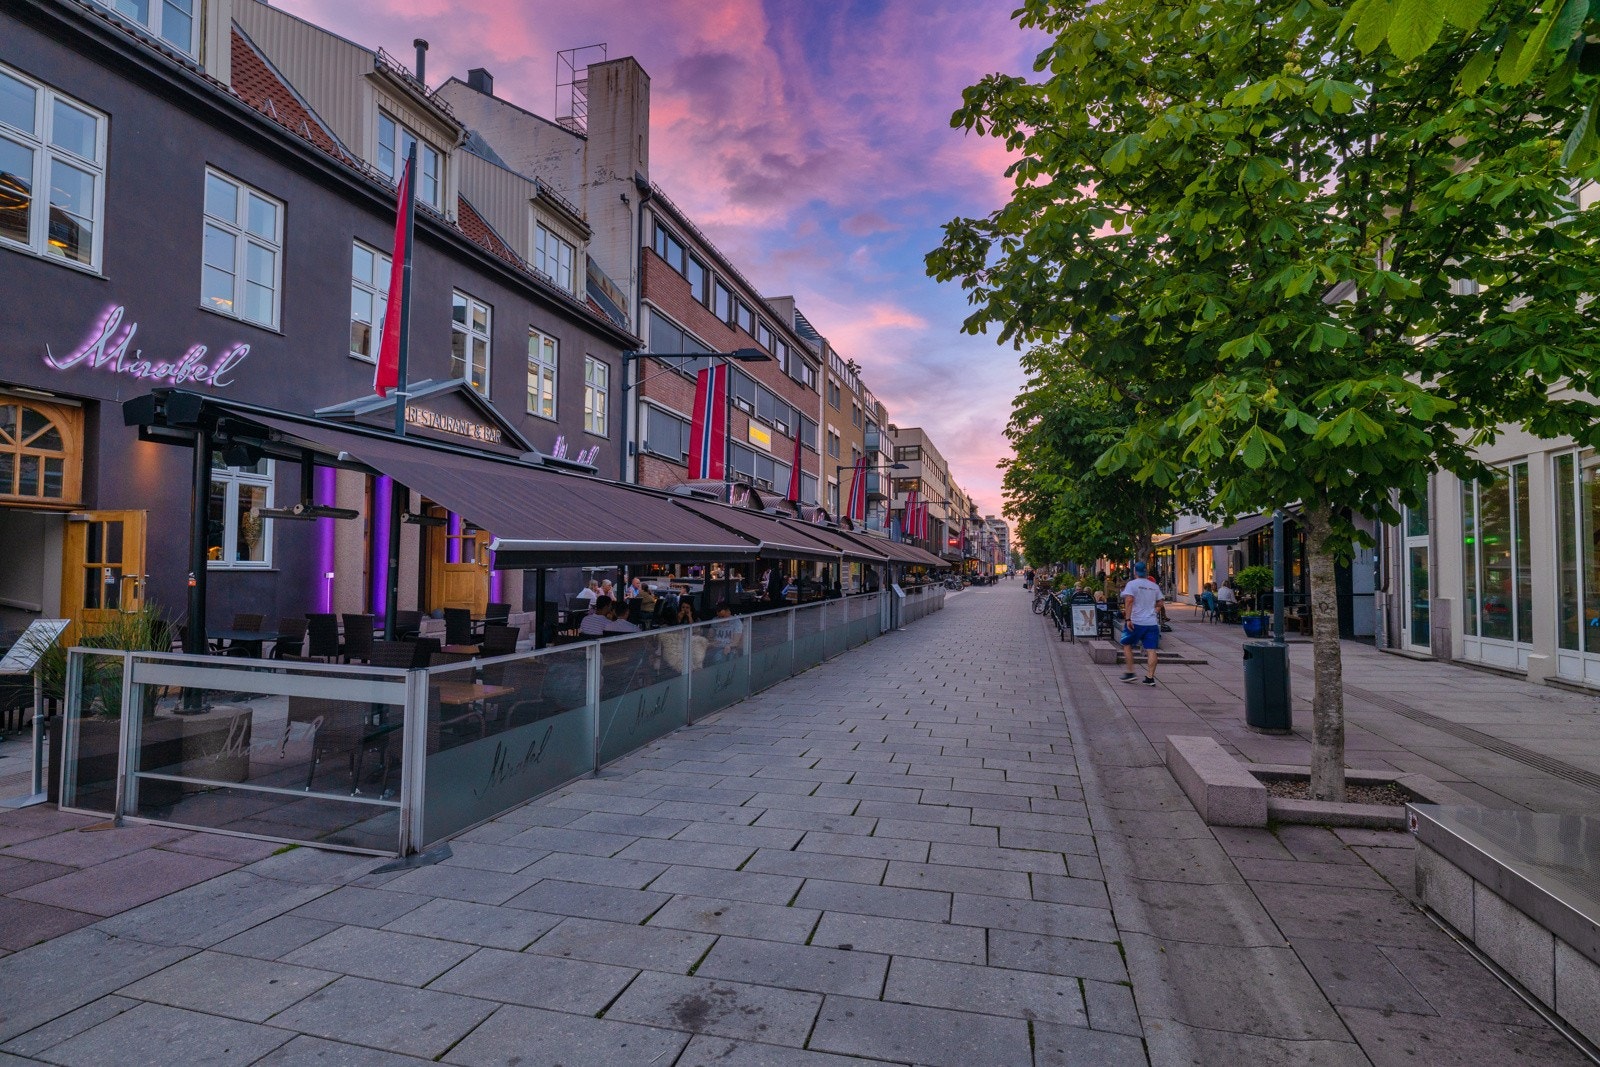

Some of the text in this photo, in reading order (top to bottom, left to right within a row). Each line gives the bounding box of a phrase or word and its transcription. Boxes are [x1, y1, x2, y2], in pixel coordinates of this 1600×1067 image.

[45, 305, 251, 387] Mirabel
[408, 406, 503, 443] RESTAURANT & BAR
